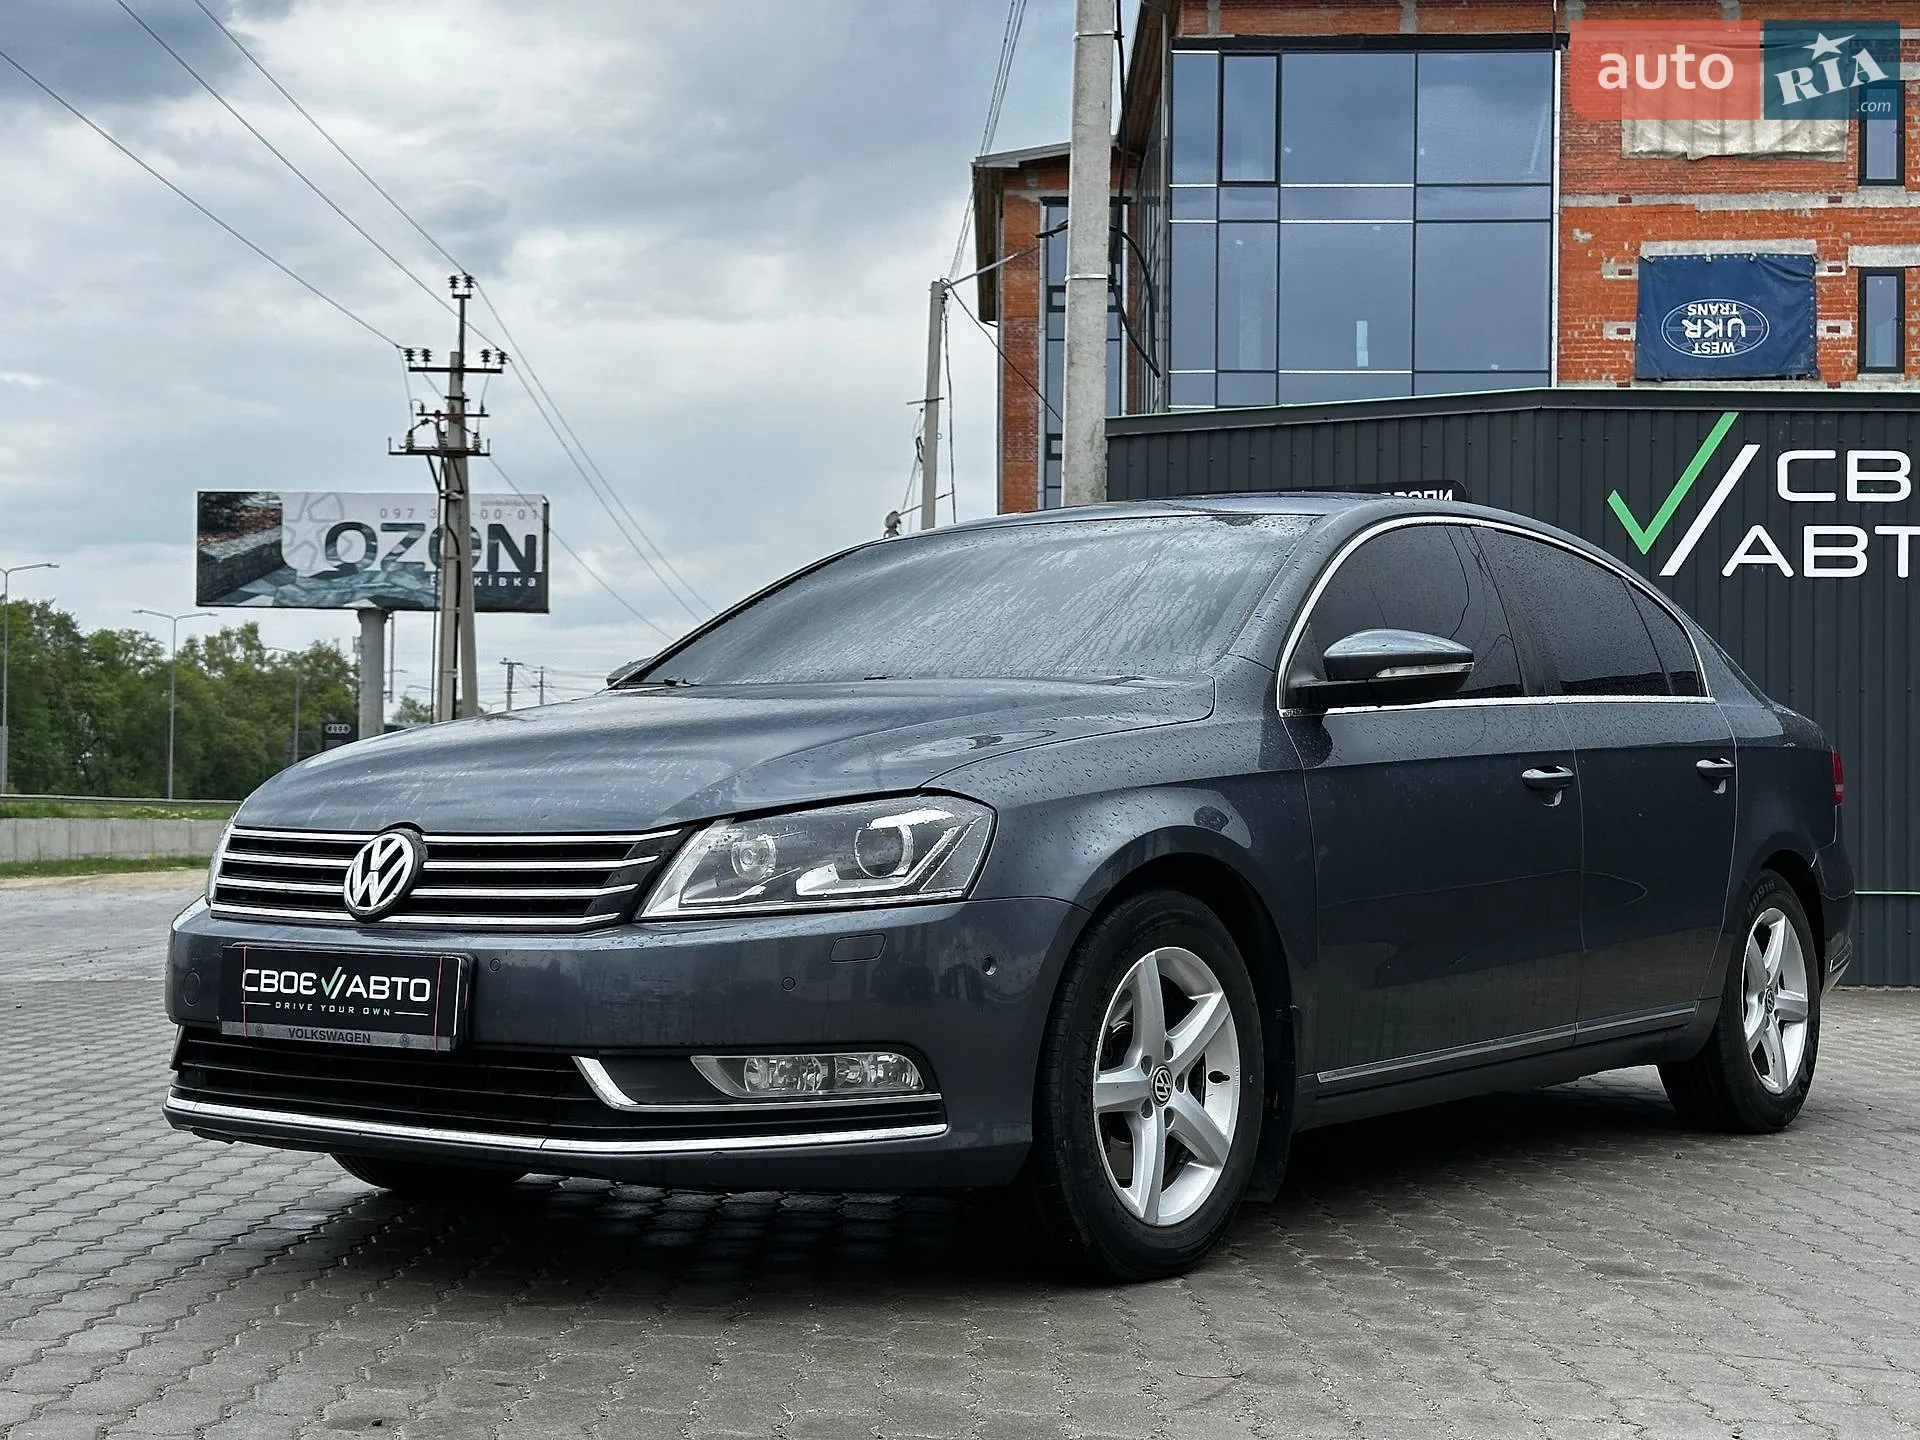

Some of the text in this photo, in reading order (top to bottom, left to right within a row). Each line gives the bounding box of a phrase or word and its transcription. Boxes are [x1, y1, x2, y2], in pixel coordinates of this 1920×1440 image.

[1687, 303, 1739, 316] TRANS
[1681, 318, 1746, 338] UKR
[1692, 341, 1736, 354] WEST
[380, 508, 415, 519] 097
[345, 974, 431, 1002] АВТО
[275, 1001, 391, 1016] DRIVE YOUR OWN
[288, 1027, 371, 1044] VOLKSWAGEN
